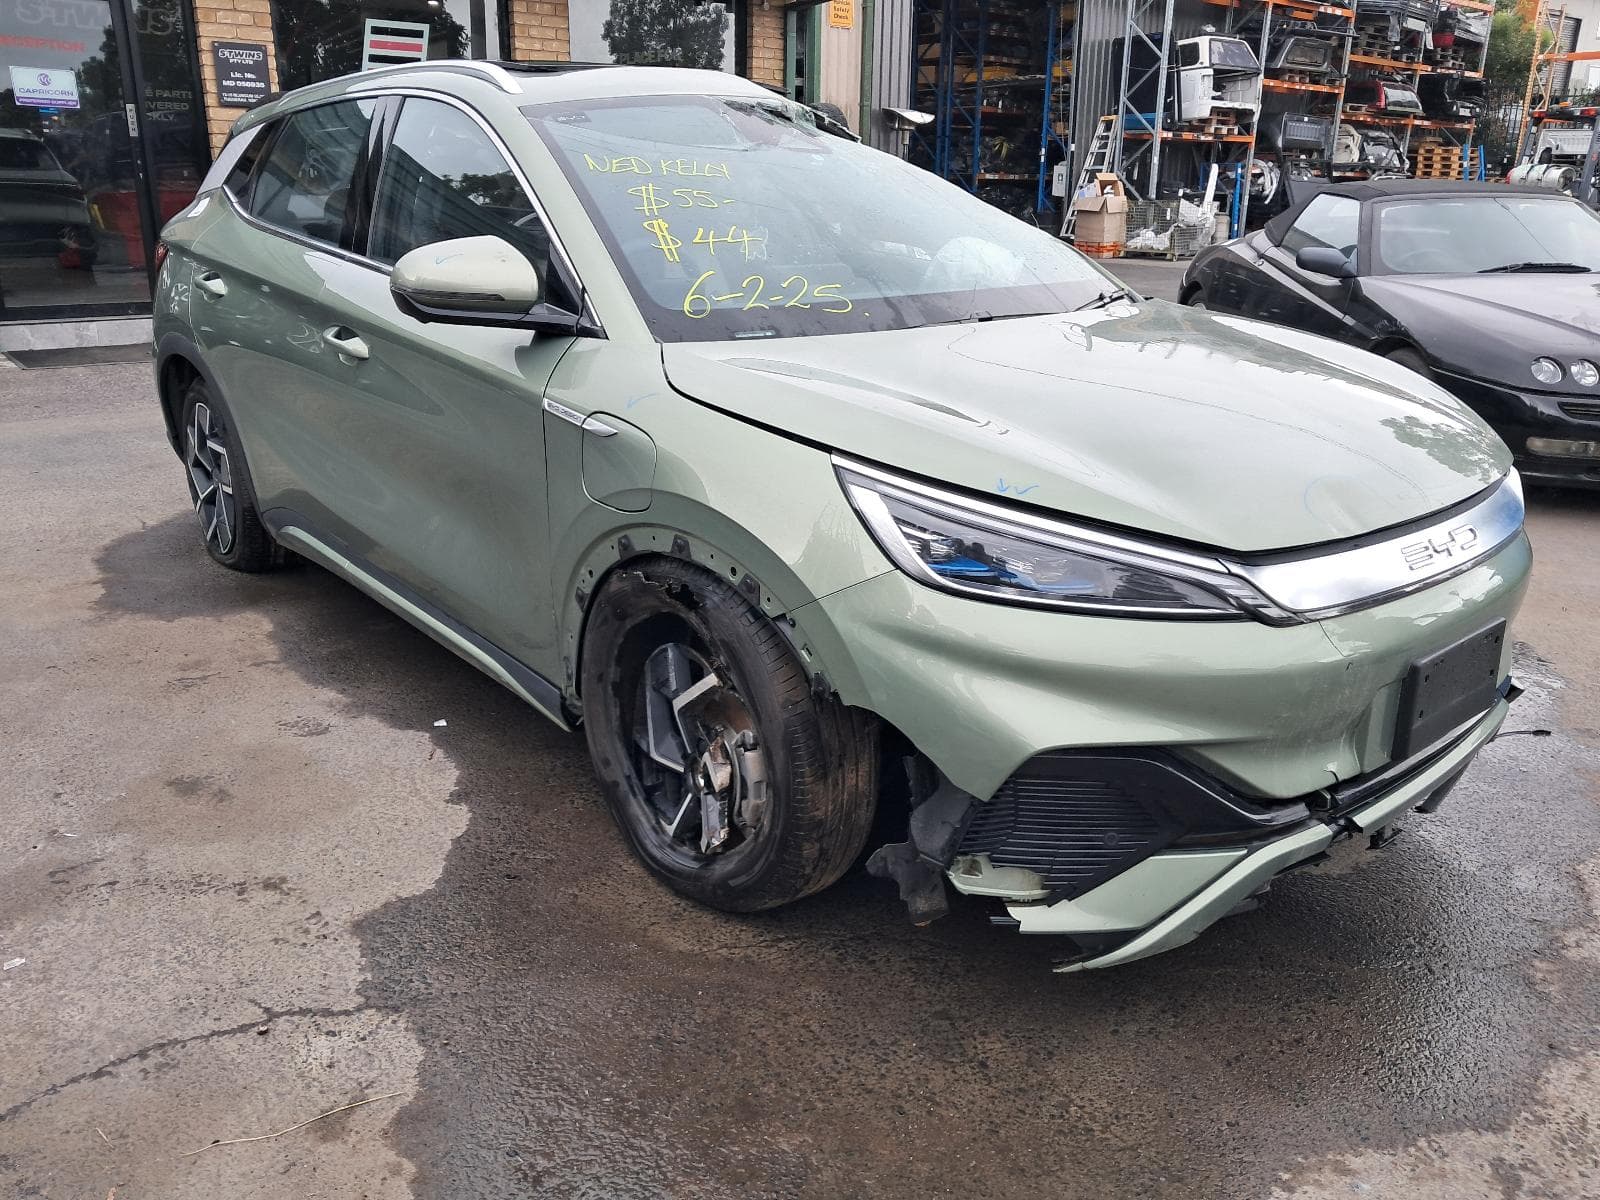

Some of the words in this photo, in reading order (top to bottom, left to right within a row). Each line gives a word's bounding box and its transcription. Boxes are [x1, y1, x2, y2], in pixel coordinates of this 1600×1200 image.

[219, 49, 263, 61] STWINS
[18, 87, 74, 96] CAPRICORN
[583, 153, 652, 175] NED
[1401, 523, 1478, 571] BYD
